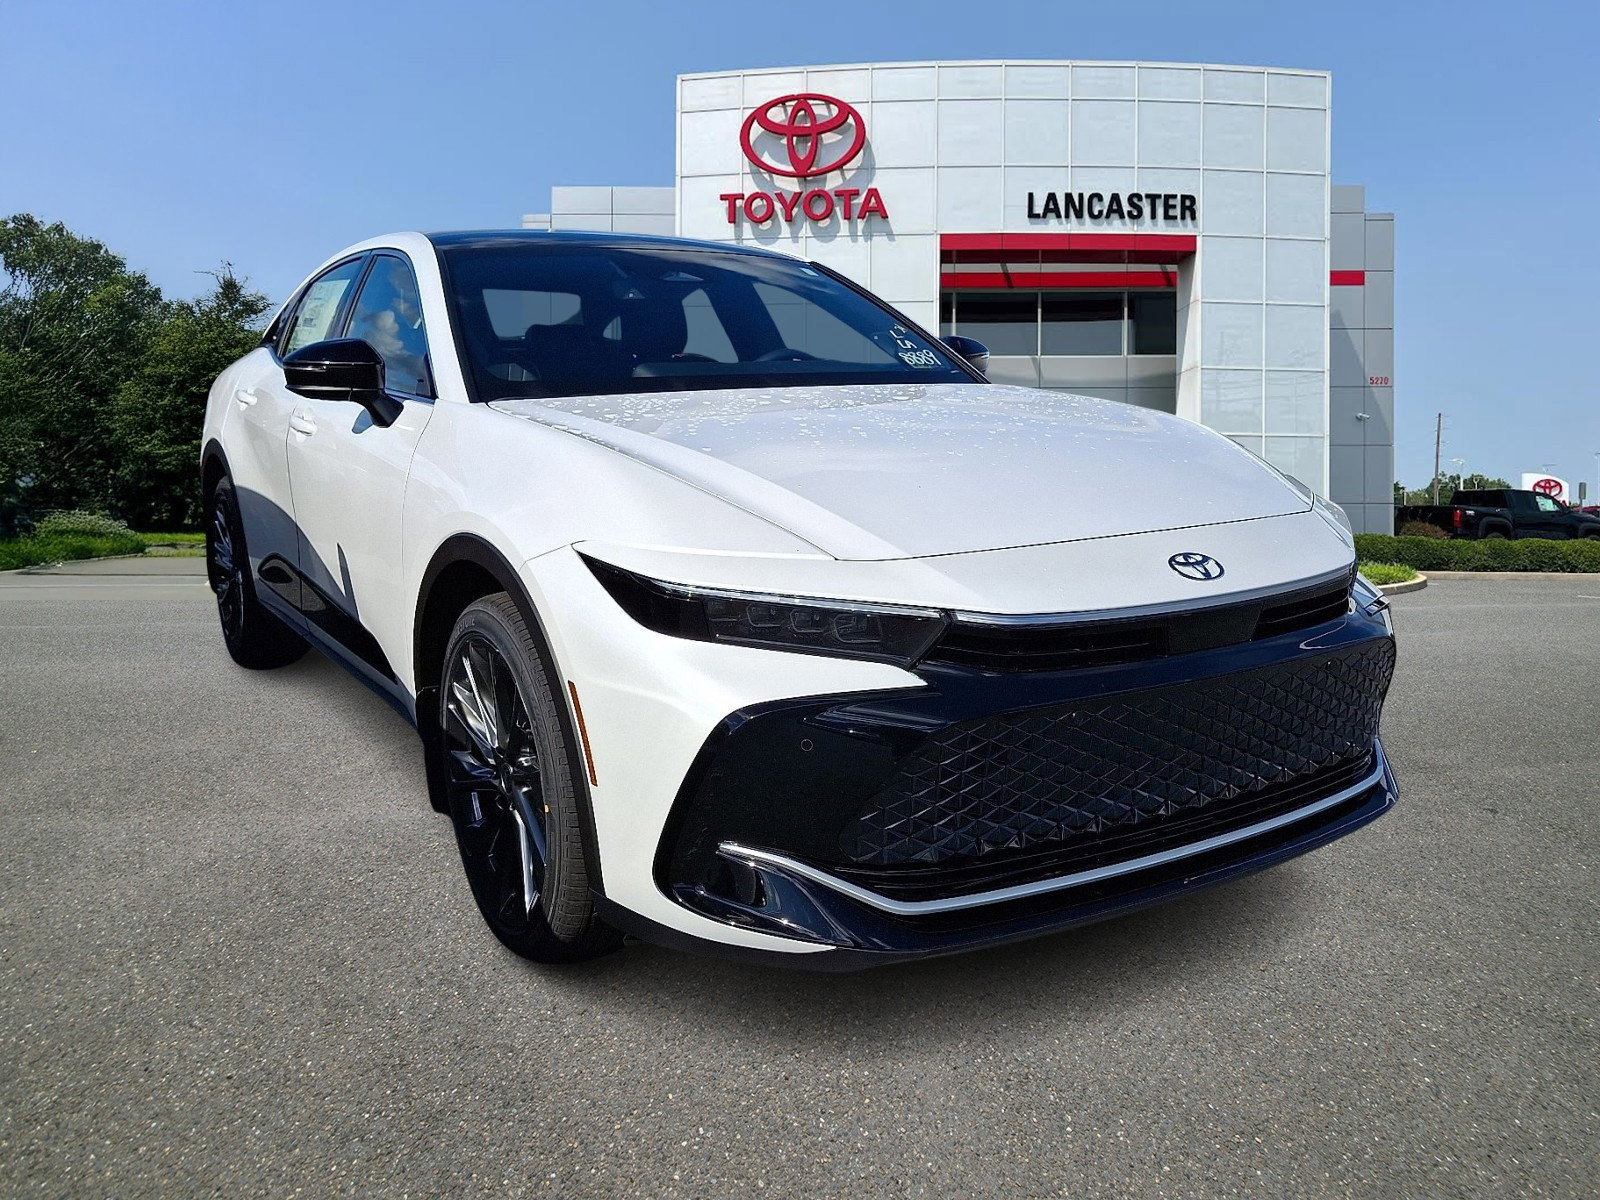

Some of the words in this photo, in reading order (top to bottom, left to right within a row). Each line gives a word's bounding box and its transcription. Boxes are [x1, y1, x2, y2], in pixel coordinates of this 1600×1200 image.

[720, 188, 889, 224] TOYOTA
[1027, 192, 1197, 221] LANCASTER
[1369, 376, 1389, 385] 5270
